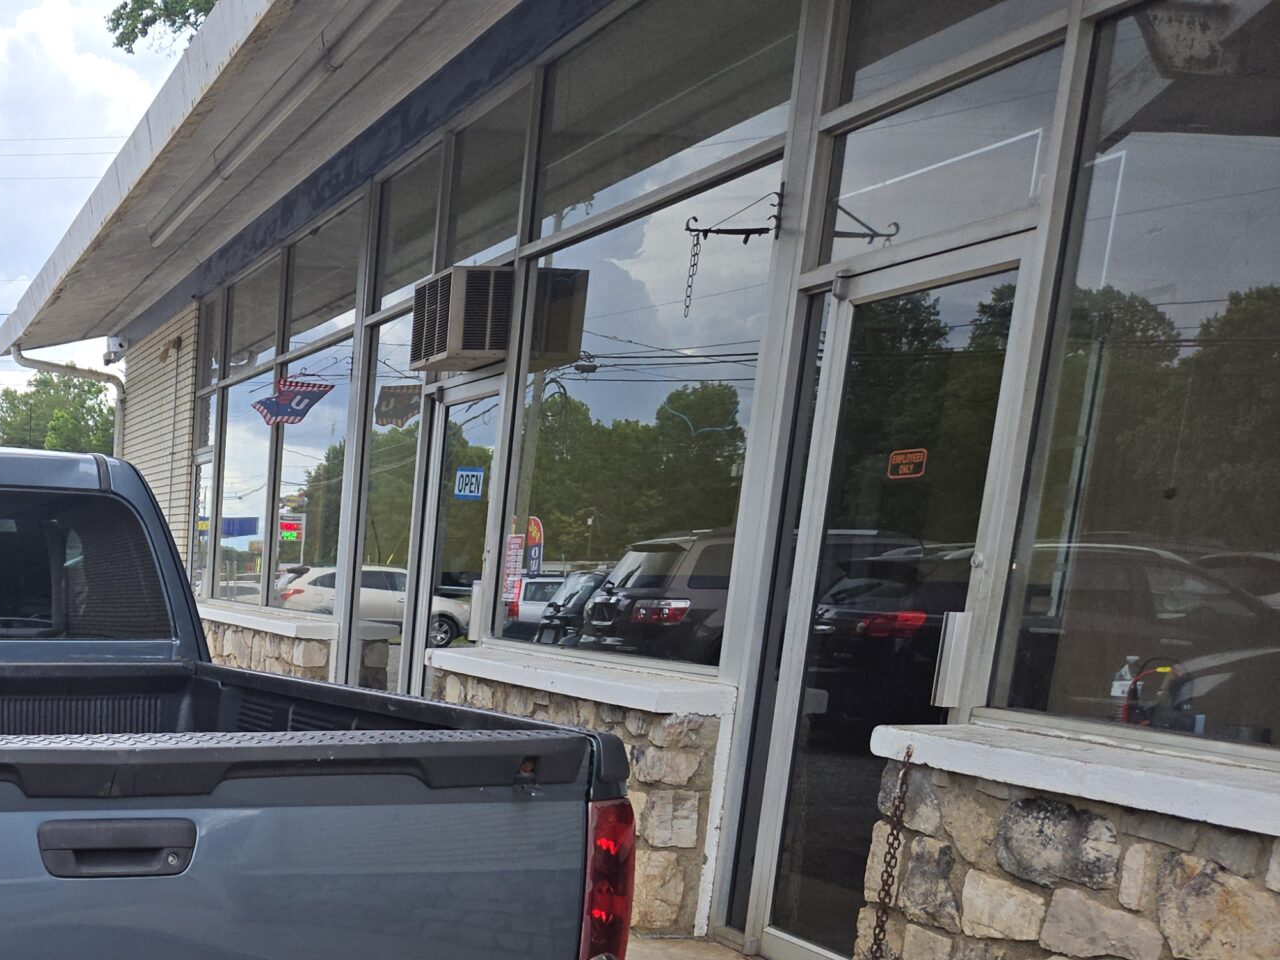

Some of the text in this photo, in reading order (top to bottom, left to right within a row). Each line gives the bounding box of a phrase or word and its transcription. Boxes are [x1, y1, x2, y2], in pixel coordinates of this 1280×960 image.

[891, 452, 924, 464] EMPLOYEES
[898, 463, 915, 474] ONLY
[457, 473, 482, 495] OPEN
